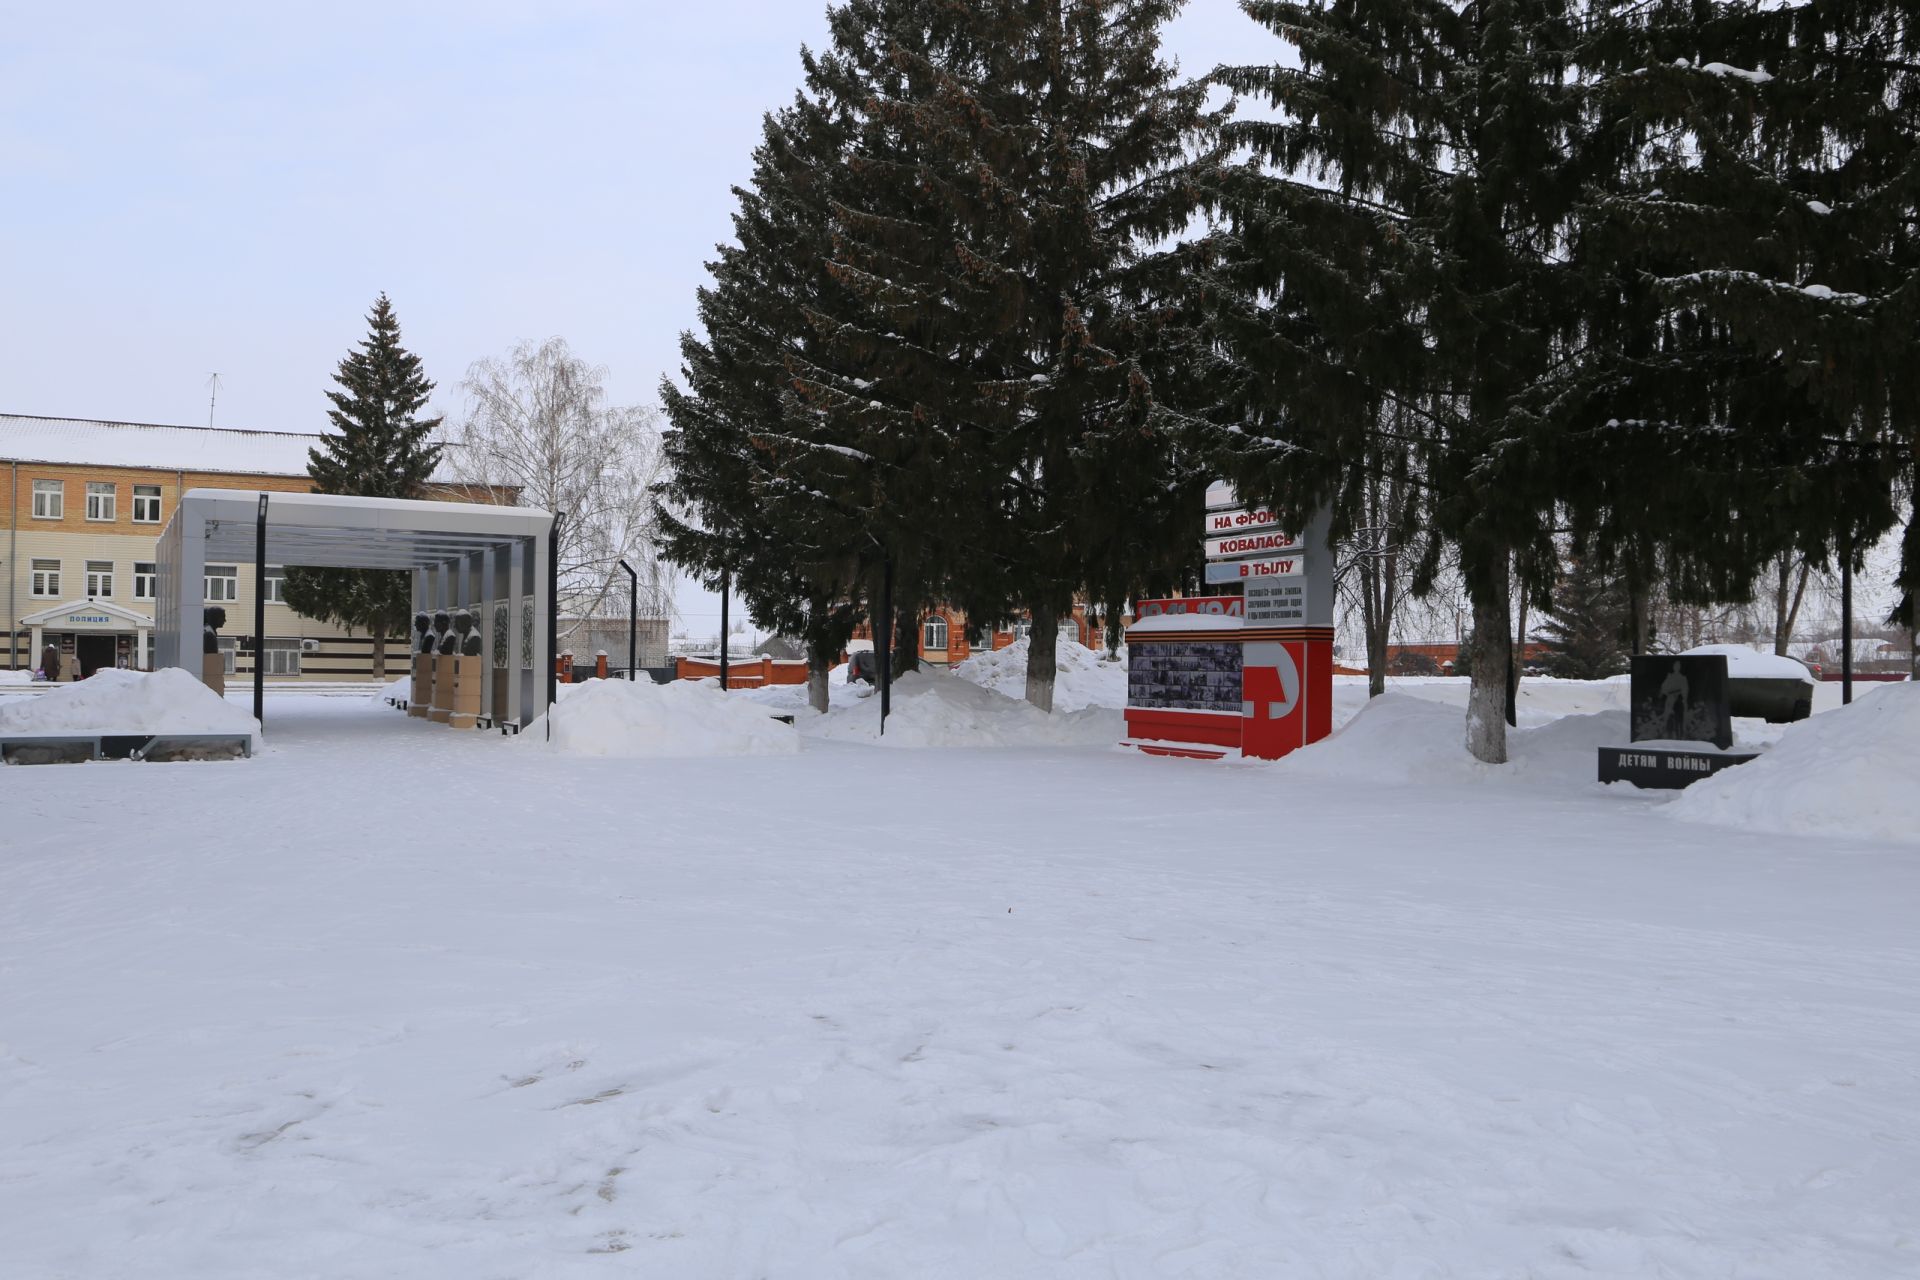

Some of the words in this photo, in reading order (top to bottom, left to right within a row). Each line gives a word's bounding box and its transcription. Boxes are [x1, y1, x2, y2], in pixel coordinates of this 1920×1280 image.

[1214, 516, 1232, 529] НА
[1236, 511, 1279, 526] ФРОН
[1240, 564, 1249, 577] В
[1253, 560, 1294, 576] ТЫЛУ
[1618, 754, 1657, 768] ДЕТЯМ
[1667, 756, 1711, 772] ВОЙНЫ
